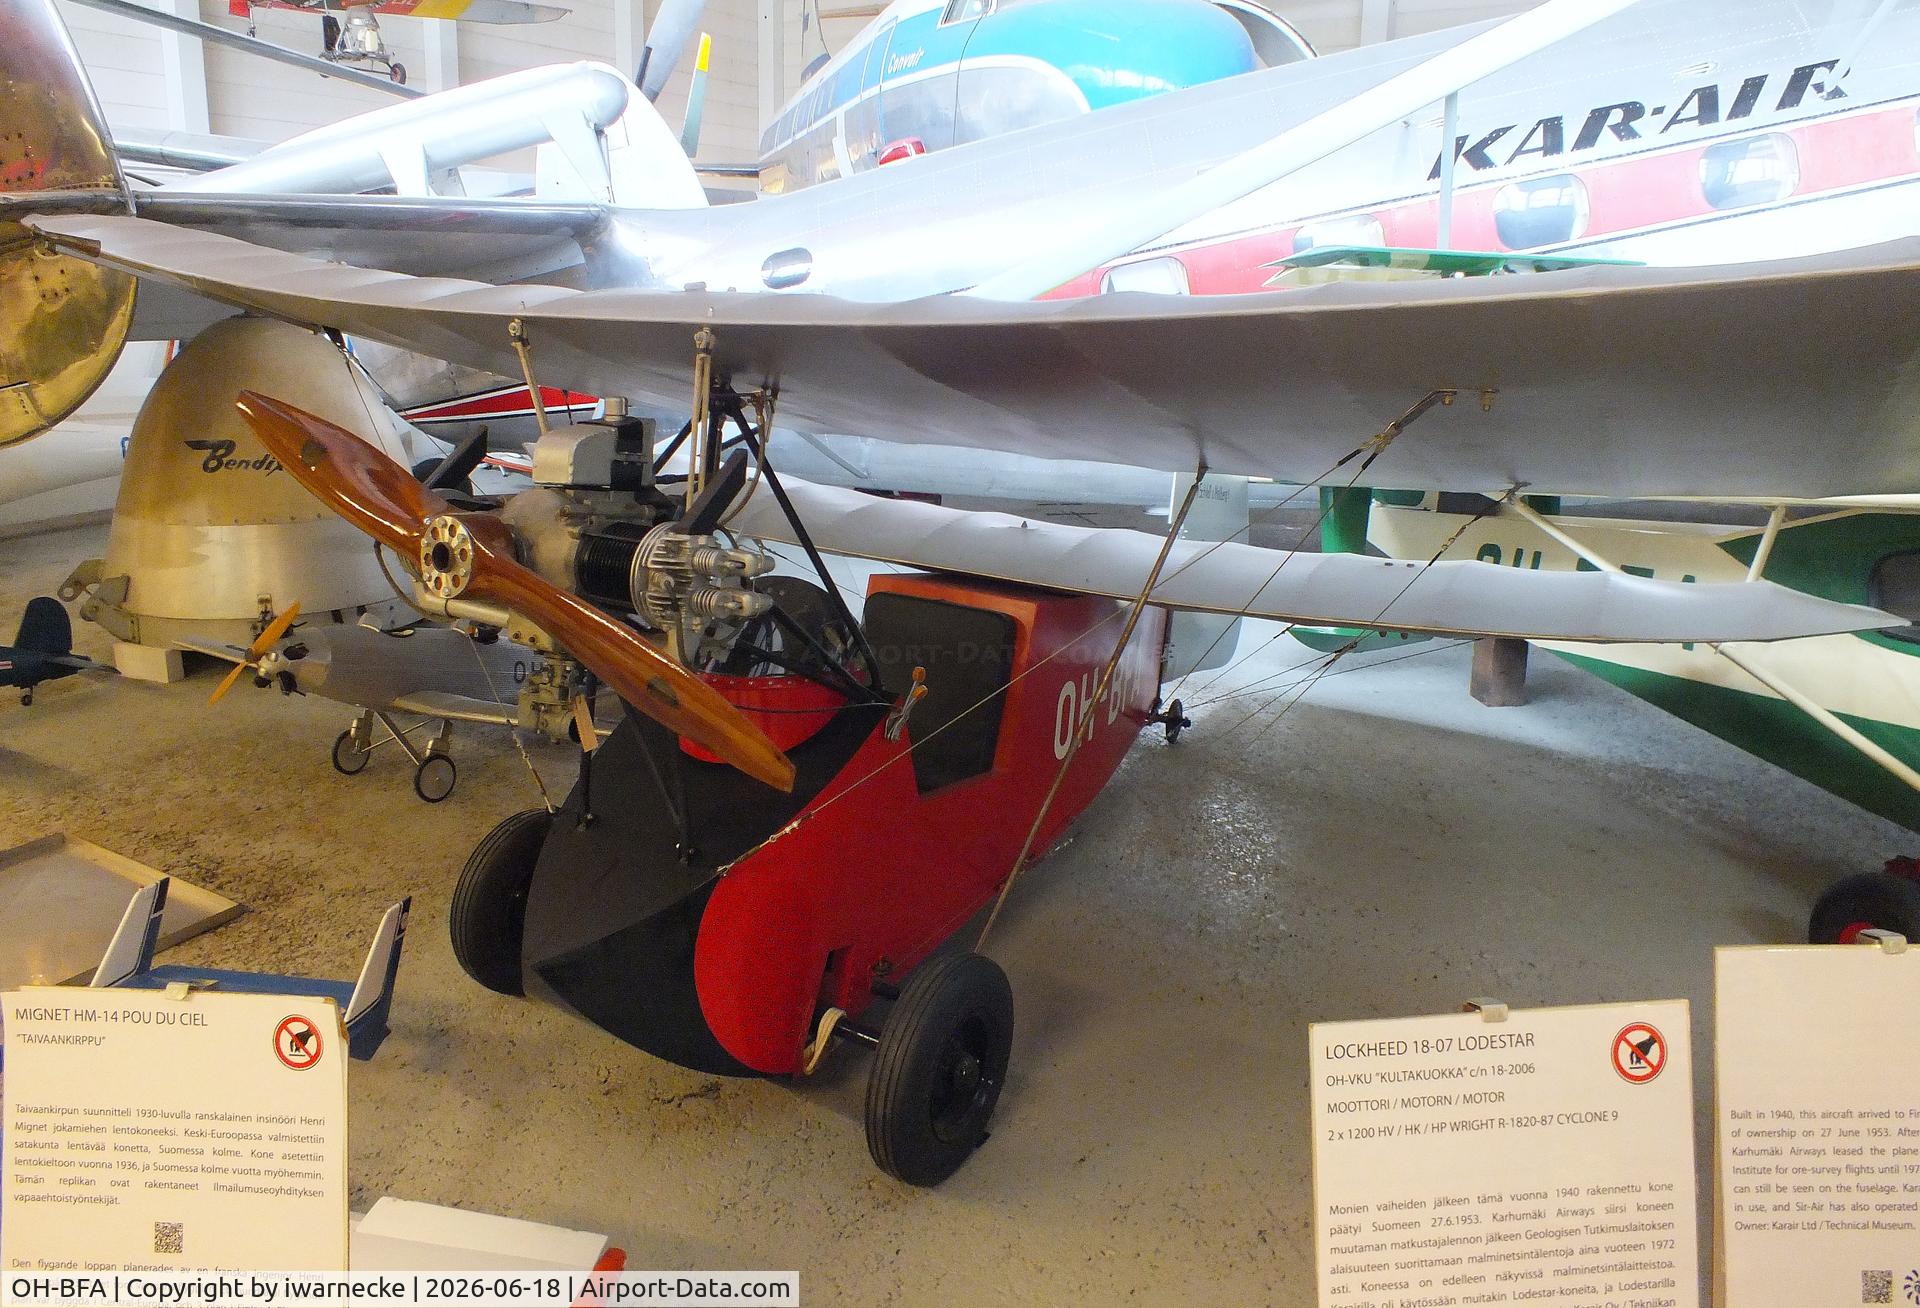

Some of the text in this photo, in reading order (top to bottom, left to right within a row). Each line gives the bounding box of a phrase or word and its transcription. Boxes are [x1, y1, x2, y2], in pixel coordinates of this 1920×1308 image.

[184, 439, 284, 477] Bendix
[15, 1008, 208, 1027] MIGNET HM-14 POU DU CIEL
[1326, 1033, 1535, 1060] LOCKHEED 18-07 LODESTAR
[1326, 1073, 1372, 1087] OH-VKU
[1469, 1066, 1487, 1079] c/n
[1491, 1063, 1536, 1076] 18-2006
[1327, 1092, 1505, 1114] MOOTTORI MOTORN MOTOR
[15, 1104, 325, 1126] Taivaankirpun suunnitteli 1930-luvulla ranskalainen insinööri Henri
[1730, 1109, 1905, 1121] Built in 1940, this aircraft arrived to
[15, 1122, 325, 1144] Mignet jokamiehen lentokoneeksi. Keski-Euroopassa valmistettiin
[1328, 1110, 1619, 1141] 2 1200 HV HK HP WRIGHT R-1820-87 CYCLONE 9
[1731, 1128, 1741, 1137] of
[1746, 1128, 1796, 1139] ownership
[1820, 1128, 1831, 1137] 27
[1838, 1128, 1860, 1137] June
[14, 1139, 59, 1149] satakunta
[114, 1142, 151, 1153] konetta,
[159, 1145, 205, 1155] Suomessa
[212, 1146, 243, 1157] kolme.
[250, 1149, 274, 1159] Kone
[282, 1151, 324, 1162] asetettiin
[1789, 1146, 1826, 1158] Airways
[1833, 1146, 1863, 1156] leased
[1870, 1146, 1886, 1156] the
[1892, 1146, 1919, 1157] plane
[14, 1157, 76, 1168] lentokieltoon
[79, 1161, 112, 1169] vuonna
[116, 1160, 140, 1171] 1936,
[153, 1163, 198, 1173] Suomessa
[201, 1164, 229, 1174] kolme
[232, 1167, 261, 1176] vuotta
[1732, 1165, 1772, 1174] Institute
[1775, 1164, 1788, 1174] for
[1845, 1164, 1875, 1176] flights
[1878, 1164, 1899, 1174] until
[59, 1176, 96, 1188] replikan
[110, 1178, 130, 1187] ovat
[144, 1180, 199, 1190] rakentaneet
[1733, 1185, 1750, 1193] can
[1755, 1183, 1771, 1193] still
[1776, 1183, 1788, 1193] be
[1792, 1185, 1813, 1193] seen
[1819, 1185, 1831, 1193] on
[1836, 1183, 1851, 1193] the
[1329, 1204, 1369, 1216] Monien
[1376, 1199, 1427, 1212] vaiheiden
[1510, 1192, 1548, 1201] vuonna
[1555, 1187, 1580, 1198] 1940
[1586, 1184, 1642, 1196] rakennettu
[1648, 1182, 1674, 1192] kone
[1734, 1202, 1743, 1211] in
[1772, 1202, 1790, 1211] and
[1829, 1202, 1845, 1211] has
[1850, 1202, 1870, 1211] also
[1874, 1202, 1918, 1213] operated
[1372, 1220, 1421, 1232] Suomeen
[1556, 1206, 1595, 1219] Airways
[1636, 1201, 1674, 1212] koneen
[1801, 1220, 1817, 1230] Ltd
[1826, 1220, 1870, 1230] Technical
[1330, 1243, 1387, 1255] muutaman
[1525, 1227, 1581, 1241] Geologisen
[12, 1258, 31, 1268] Den
[1330, 1262, 1390, 1275] alaisuuteen
[1394, 1255, 1463, 1270] suorittamaan
[1579, 1246, 1599, 1256] aina
[1604, 1241, 1645, 1253] vuoteen
[1651, 1239, 1675, 1250] 1972
[1361, 1279, 1409, 1292] Koneessa
[1419, 1278, 1432, 1288] on
[1442, 1273, 1486, 1286] edelleen
[1462, 1292, 1507, 1304] muitakin
